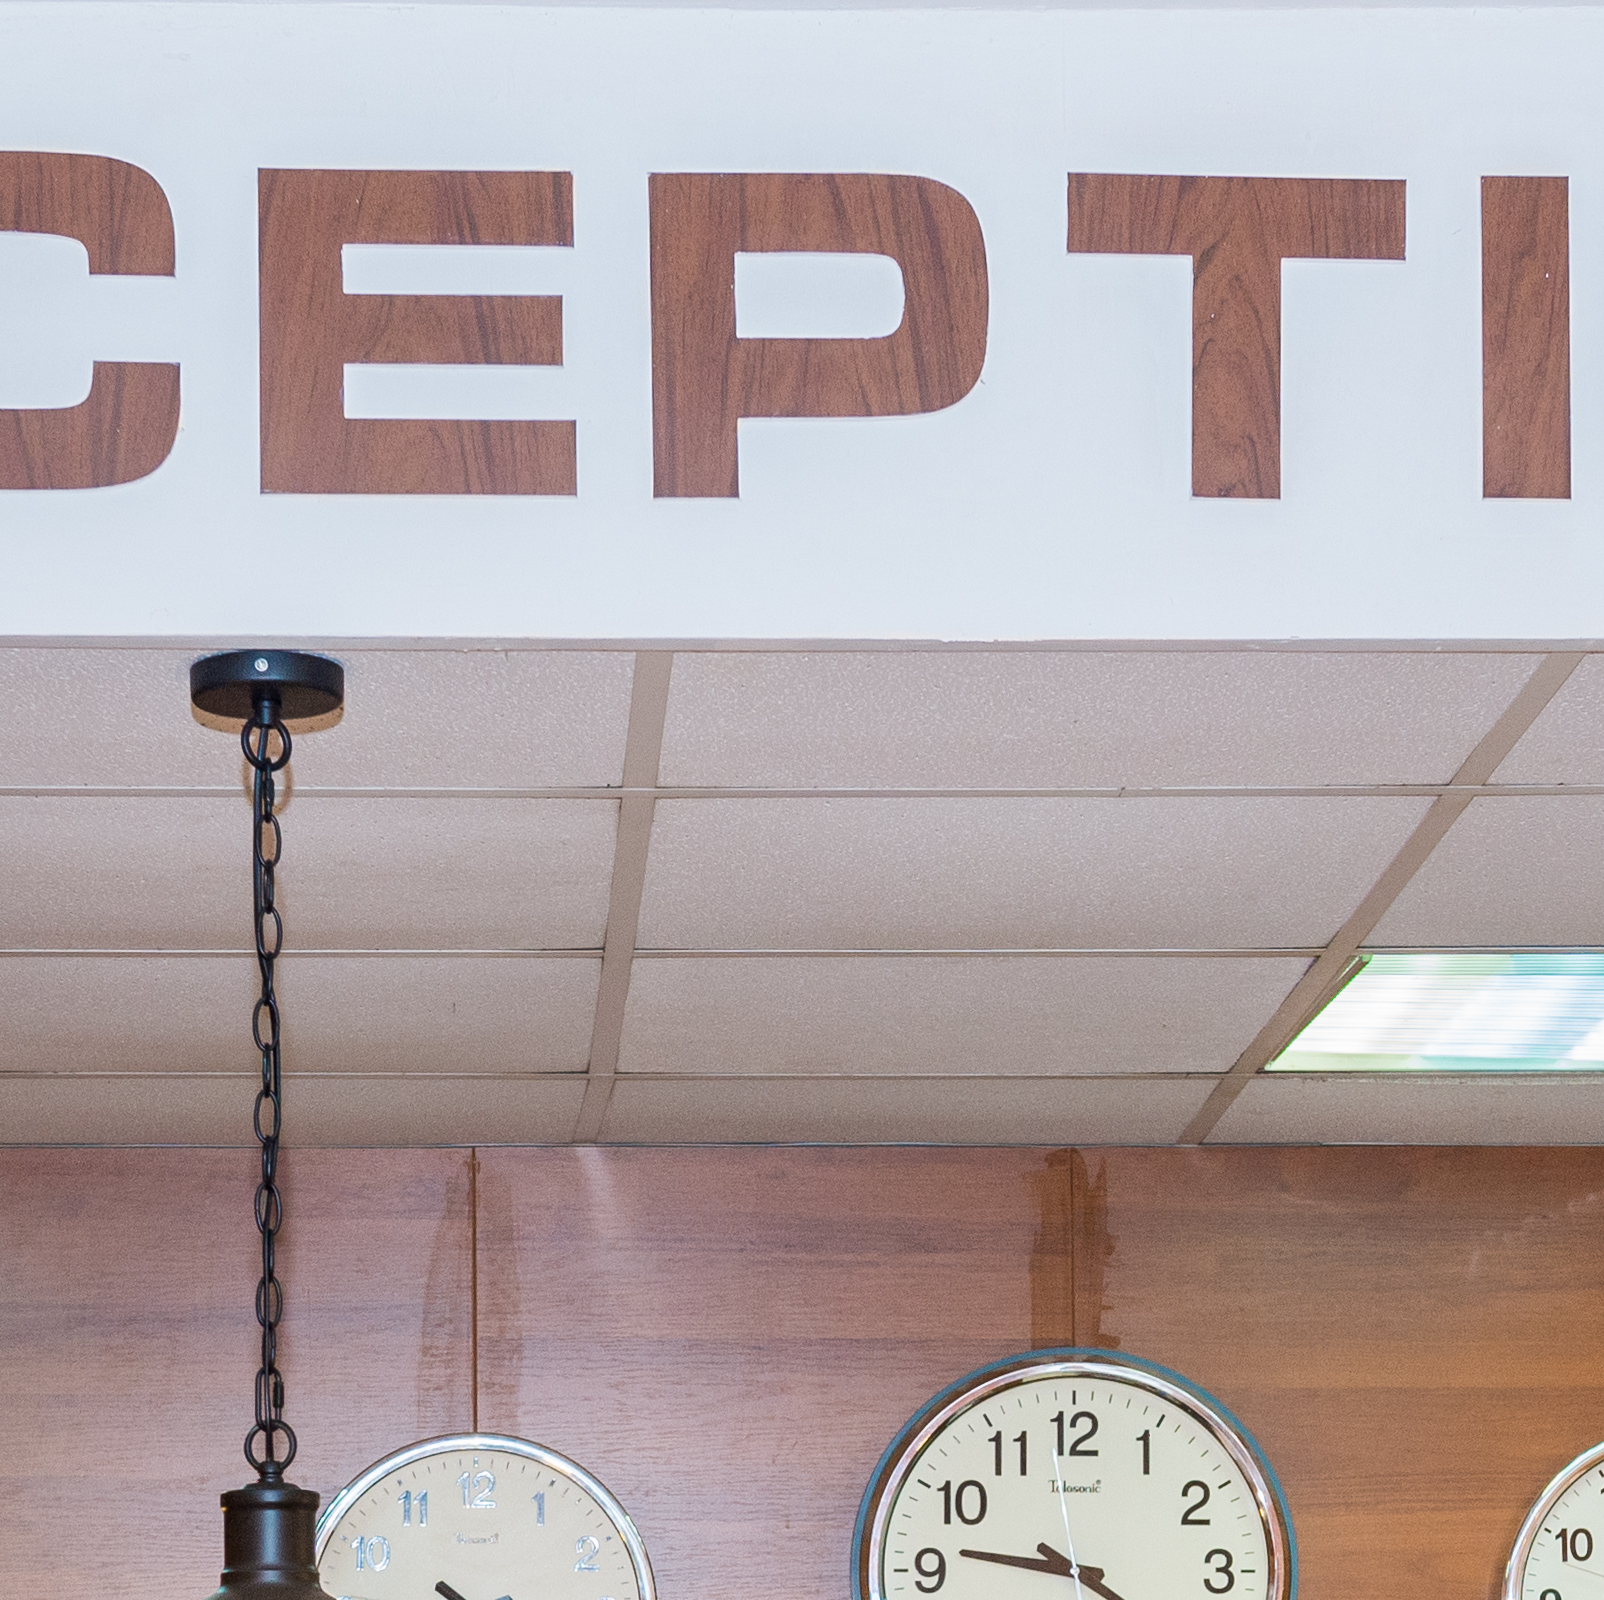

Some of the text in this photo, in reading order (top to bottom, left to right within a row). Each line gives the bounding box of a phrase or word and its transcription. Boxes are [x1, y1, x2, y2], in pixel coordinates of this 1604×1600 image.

[988, 1430, 1029, 1477] 11
[1050, 1410, 1099, 1458] 12
[1135, 1429, 1151, 1476] 1
[397, 1489, 428, 1528] 11
[456, 1470, 497, 1509] 12
[532, 1491, 546, 1526] 1
[937, 1479, 988, 1526] 10
[1180, 1480, 1211, 1526] 2
[350, 1535, 391, 1572] 10
[574, 1535, 601, 1572] 2
[1555, 1528, 1594, 1562] 10
[914, 1547, 947, 1594] 9
[1202, 1548, 1235, 1595] 3
